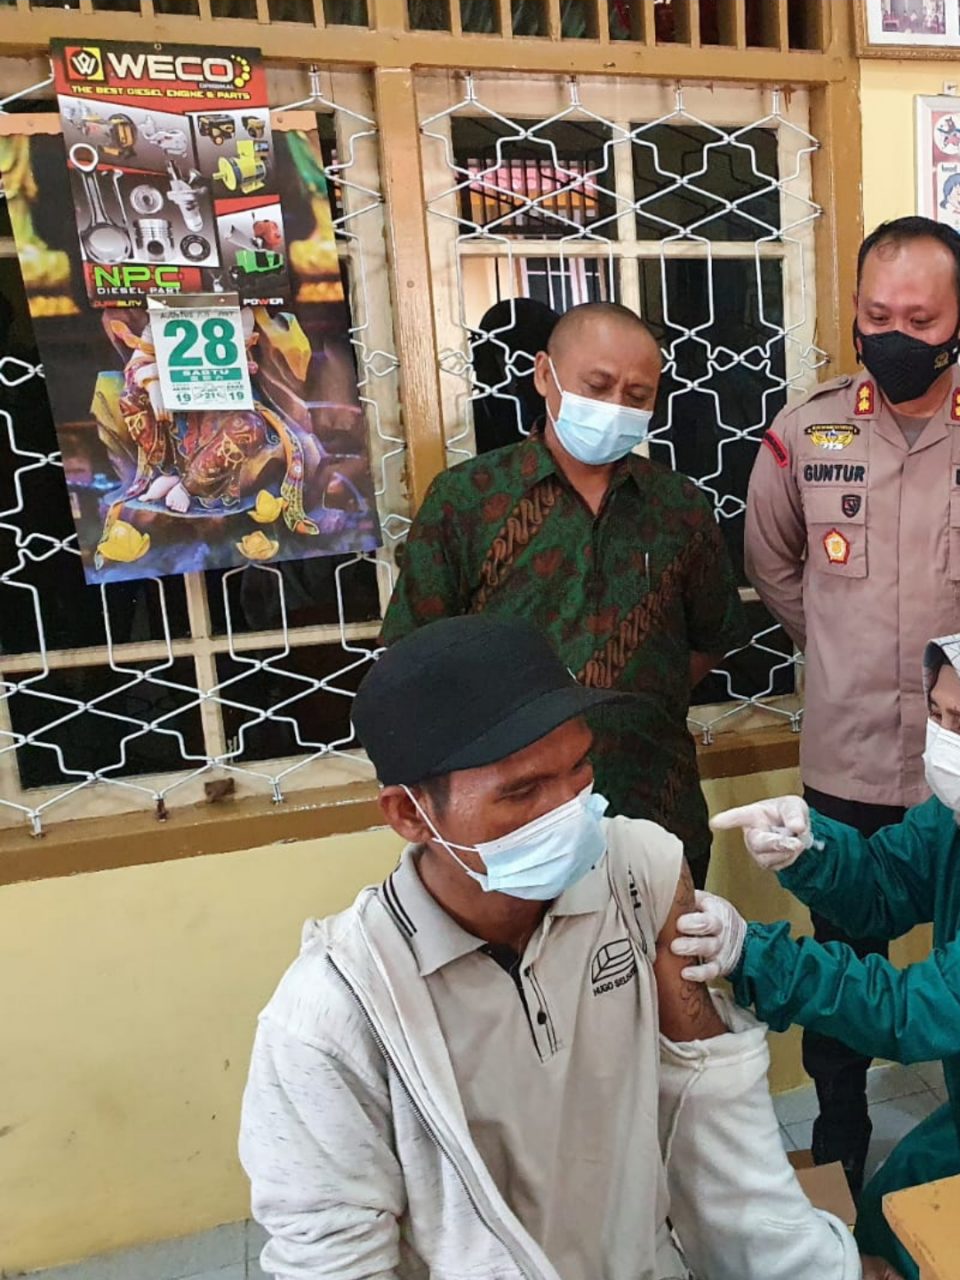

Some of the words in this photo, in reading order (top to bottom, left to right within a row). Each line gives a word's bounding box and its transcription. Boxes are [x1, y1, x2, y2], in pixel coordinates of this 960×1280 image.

[106, 51, 235, 83] WECO
[71, 85, 93, 94] THE
[96, 86, 124, 95] BEST
[127, 87, 164, 97] DIESEL
[166, 88, 204, 98] ENGINE
[216, 91, 251, 100] PARTS
[94, 266, 181, 288] NPC
[97, 287, 145, 295] DIESEL
[149, 286, 181, 294] PART
[243, 297, 285, 306] POWER
[163, 317, 239, 368] 28
[182, 368, 230, 377] SABTU
[175, 392, 192, 403] 19
[228, 391, 245, 401] 19
[803, 464, 865, 483] GUNTUR
[592, 981, 614, 997] HUGO
